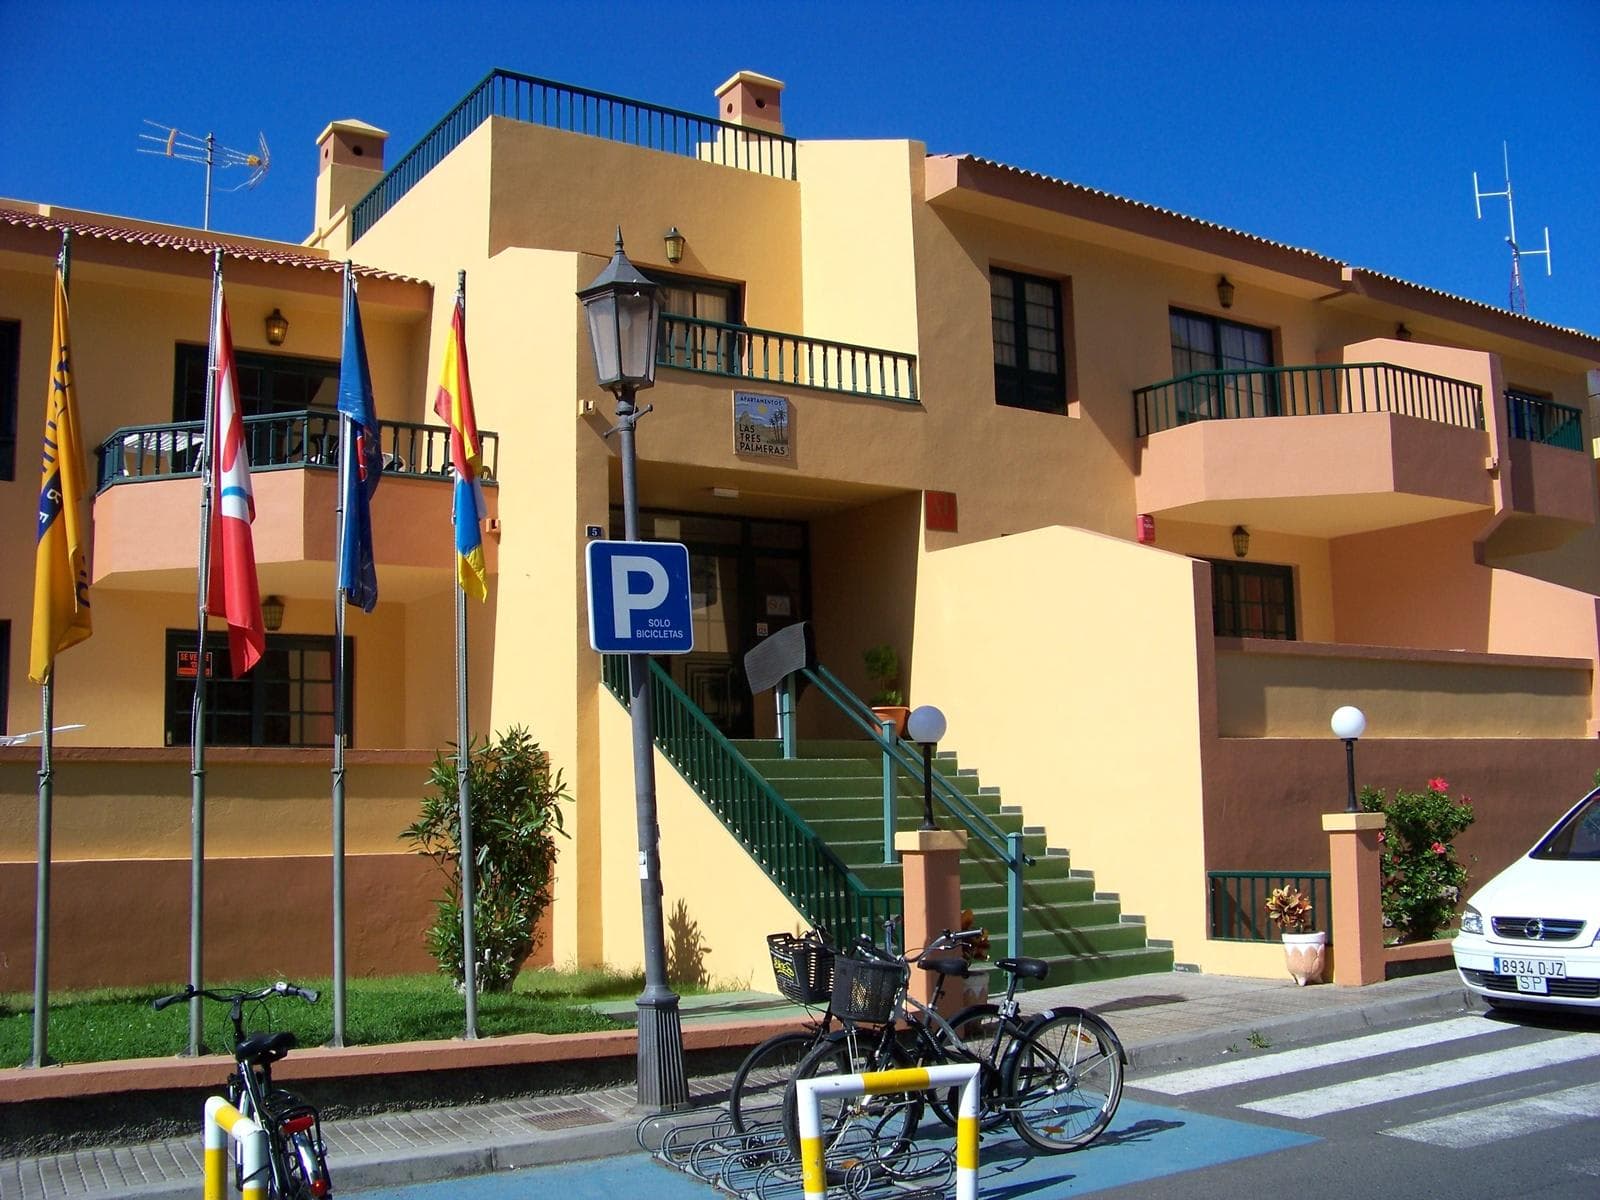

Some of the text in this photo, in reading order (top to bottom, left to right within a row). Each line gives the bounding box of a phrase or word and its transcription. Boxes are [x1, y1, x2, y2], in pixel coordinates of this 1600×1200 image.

[740, 396, 782, 406] APARTAMENTOS
[739, 424, 755, 433] LAS
[740, 433, 761, 443] TRES
[740, 442, 785, 455] PALMERAS
[591, 527, 598, 536] 5
[611, 555, 670, 639] P
[648, 619, 671, 628] SOLO
[636, 629, 684, 639] BICICLETAS
[1502, 960, 1564, 976] 8934 DJZ
[1520, 975, 1542, 990] SP
